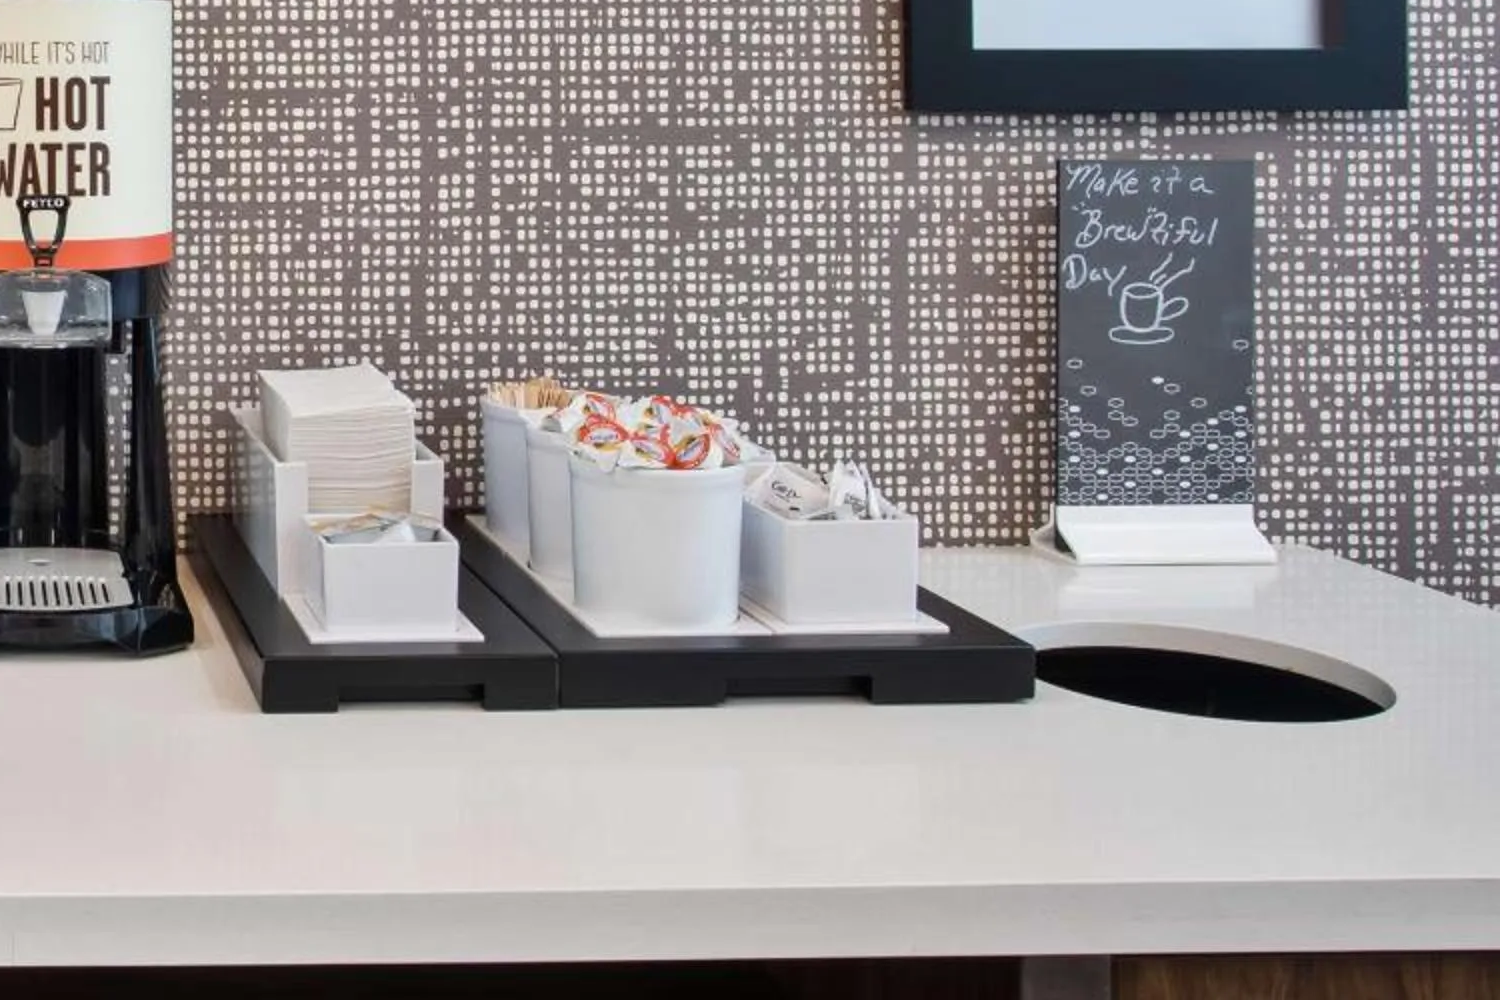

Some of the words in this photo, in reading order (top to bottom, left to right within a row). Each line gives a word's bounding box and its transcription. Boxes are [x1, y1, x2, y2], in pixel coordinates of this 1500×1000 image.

[47, 42, 75, 65] IT'S
[81, 42, 109, 65] HOT
[36, 76, 111, 131] HOT
[1065, 164, 1139, 198] Make
[1189, 177, 1214, 194] a
[1062, 253, 1128, 296] Day
